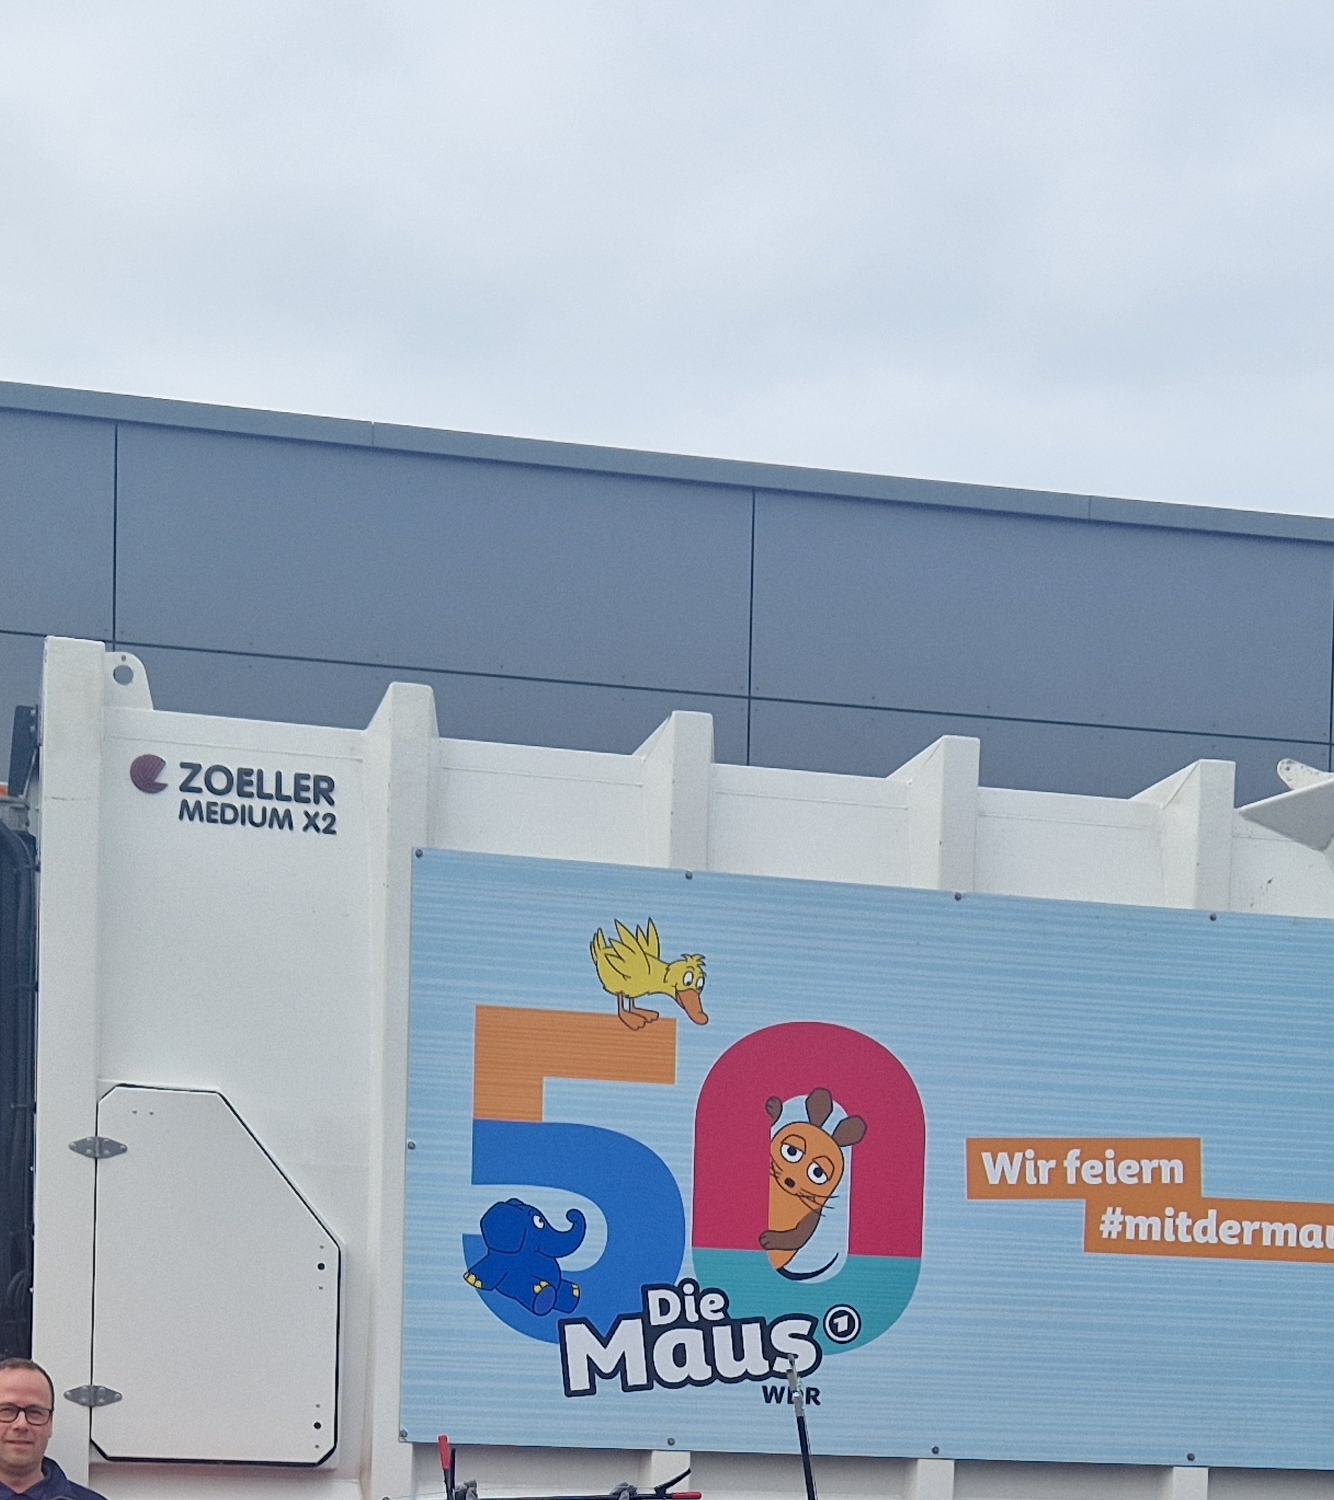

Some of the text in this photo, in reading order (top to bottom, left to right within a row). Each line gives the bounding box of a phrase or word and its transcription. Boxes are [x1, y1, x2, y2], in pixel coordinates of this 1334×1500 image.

[179, 761, 335, 806] ZOELLER
[178, 798, 337, 835] MEDIUM X2
[463, 1005, 926, 1356] 50
[981, 1148, 1184, 1186] Wir feiern
[647, 1282, 725, 1327] Die
[563, 1316, 818, 1392] Maus
